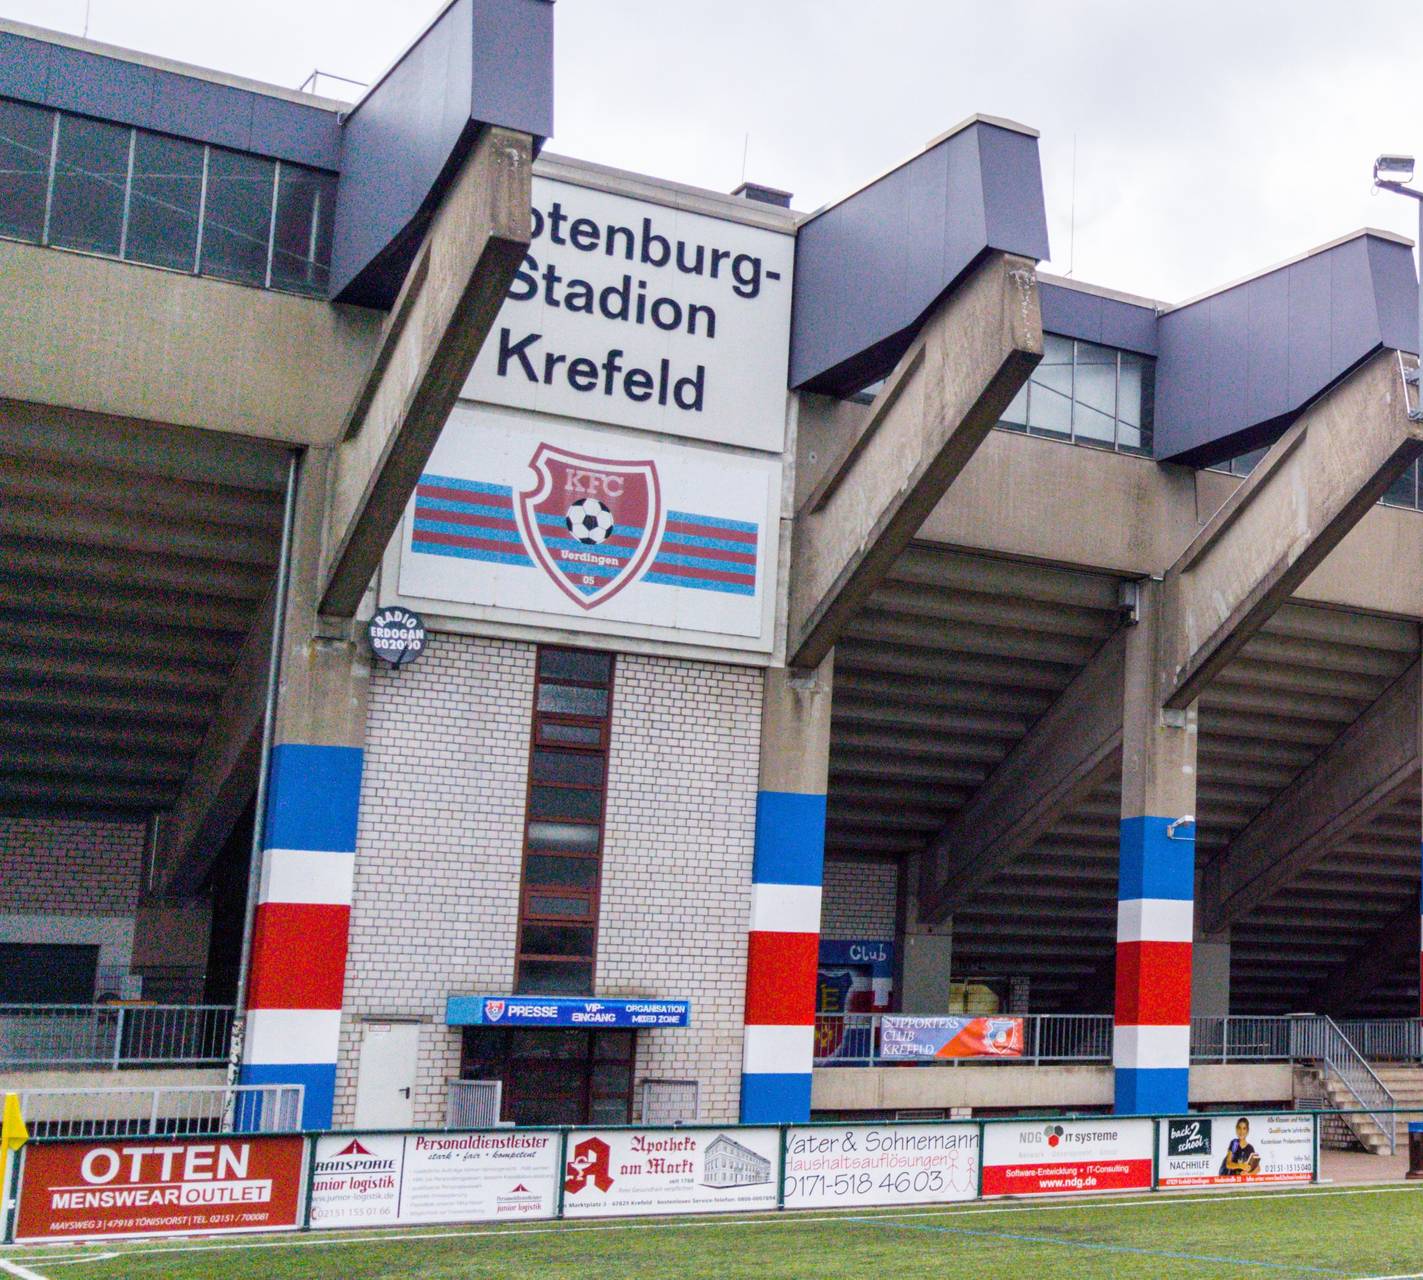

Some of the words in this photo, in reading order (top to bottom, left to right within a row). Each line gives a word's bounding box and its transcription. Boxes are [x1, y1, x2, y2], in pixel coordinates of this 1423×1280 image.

[508, 255, 717, 339] Stadion
[497, 327, 706, 412] Krefeld
[565, 468, 625, 497] KFC
[561, 550, 619, 566] Uerdingen
[582, 576, 595, 585] 05
[375, 611, 417, 628] RADIO
[371, 626, 424, 640] ERDOGAN
[850, 944, 887, 961] Club
[508, 1005, 558, 1018] PRESSE
[585, 1003, 605, 1012] VIP-
[625, 1005, 685, 1013] ORGANISATION
[571, 1012, 616, 1022] EINGANG
[632, 1015, 657, 1023] MIXED
[658, 1014, 680, 1023] ZONE
[1020, 1131, 1042, 1144] NDG
[1065, 1133, 1074, 1142] IT
[1171, 1125, 1191, 1139] back
[1189, 1122, 1201, 1140] 2
[415, 1134, 550, 1151] Personaldienstleister
[631, 1135, 697, 1155] Apotheke
[842, 1131, 857, 1152] &
[865, 1130, 980, 1152] Sohnemann
[1178, 1136, 1204, 1152] school
[427, 1151, 452, 1160] stark
[492, 1150, 537, 1161] kompetent
[81, 1144, 250, 1184] OTTEN
[314, 1159, 397, 1171] RANSPORTE
[620, 1163, 642, 1175] am
[646, 1158, 694, 1174] Markt
[1005, 1167, 1078, 1178] Software-Entwicklung
[1086, 1165, 1129, 1175] IT-Consulting
[1169, 1160, 1210, 1170] NACHHILFE
[312, 1176, 347, 1192] unior
[349, 1175, 395, 1193] logistik
[784, 1173, 873, 1198] 0171-518
[878, 1169, 944, 1193] 4603
[1039, 1176, 1097, 1188] www.ndg.de
[51, 1188, 180, 1210] MENSWEAR
[185, 1185, 267, 1203] OUTLET
[50, 1219, 95, 1231] MAYSWEG
[106, 1218, 133, 1228] 47918
[135, 1216, 186, 1226] TÖNISVORST
